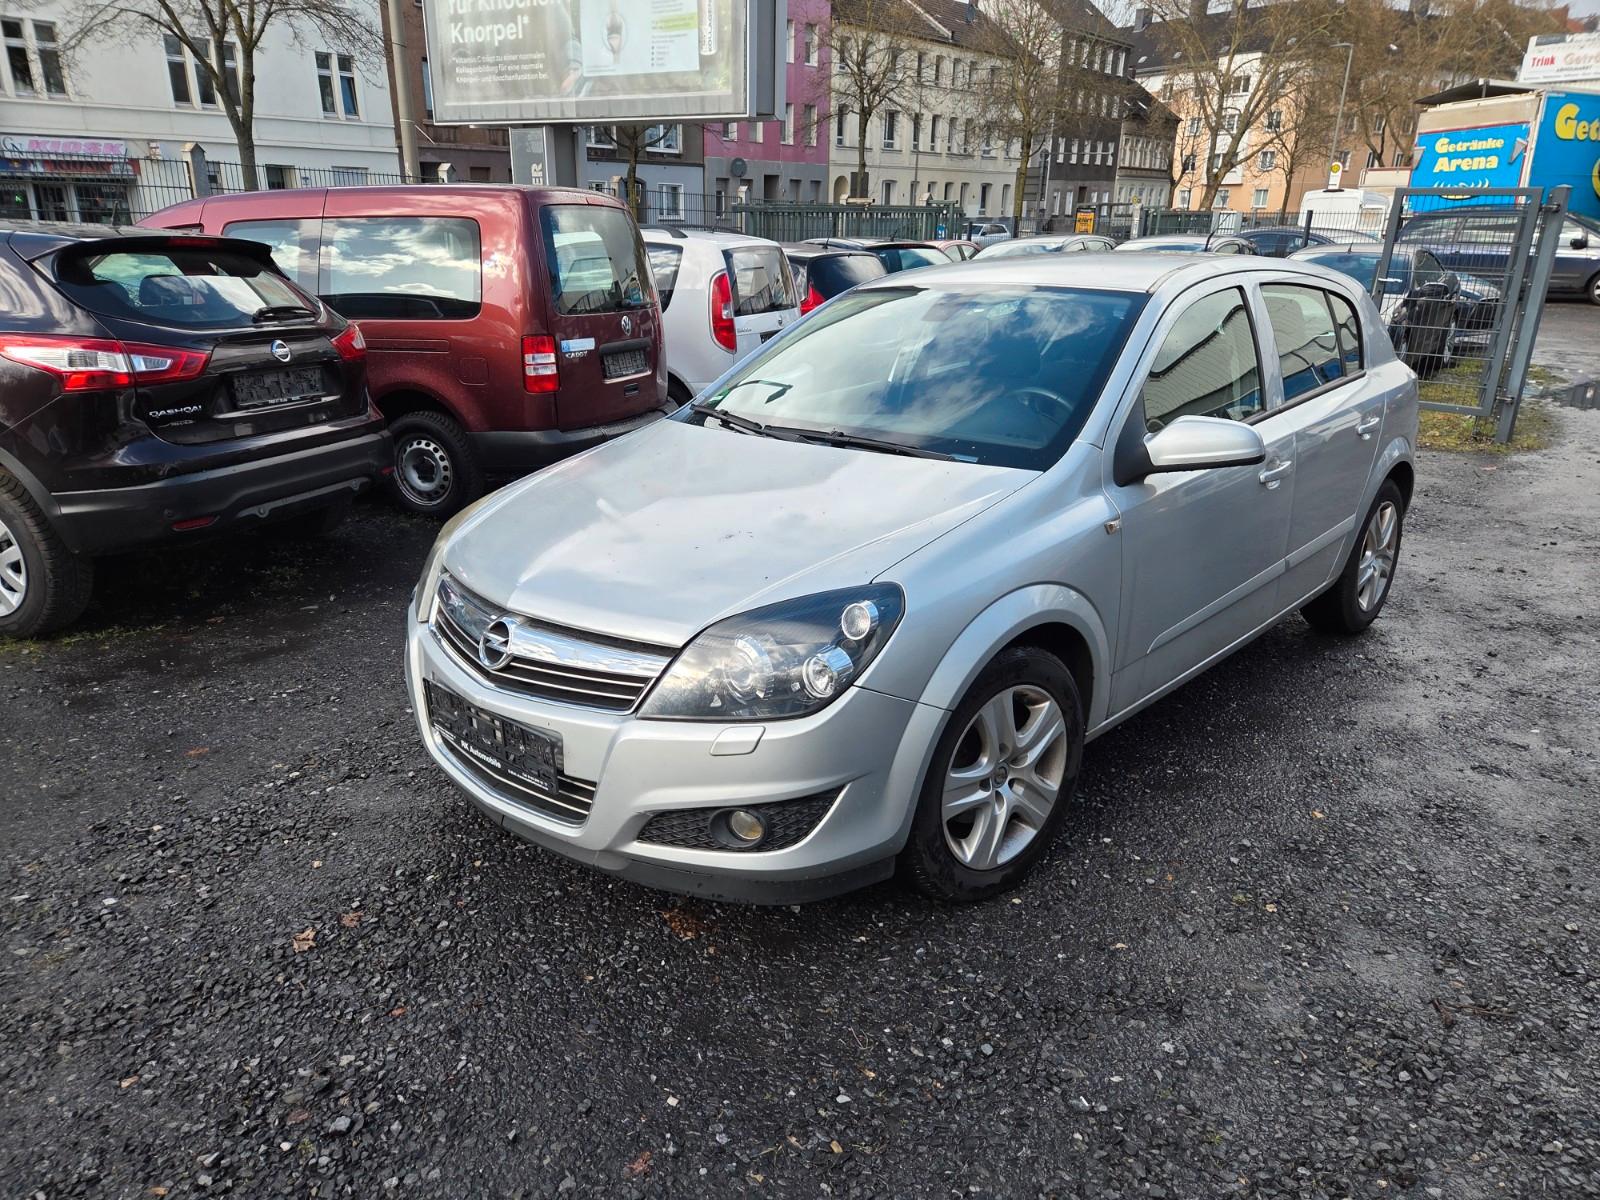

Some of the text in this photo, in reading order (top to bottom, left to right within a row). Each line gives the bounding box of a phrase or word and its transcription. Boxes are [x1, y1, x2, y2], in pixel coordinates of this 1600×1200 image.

[1531, 56, 1556, 67] Trink
[28, 140, 124, 155] KIOSK
[1435, 137, 1505, 154] Getränke
[1433, 155, 1499, 173] Arena
[565, 350, 588, 359] CADDY
[149, 405, 202, 419] QASHQAI
